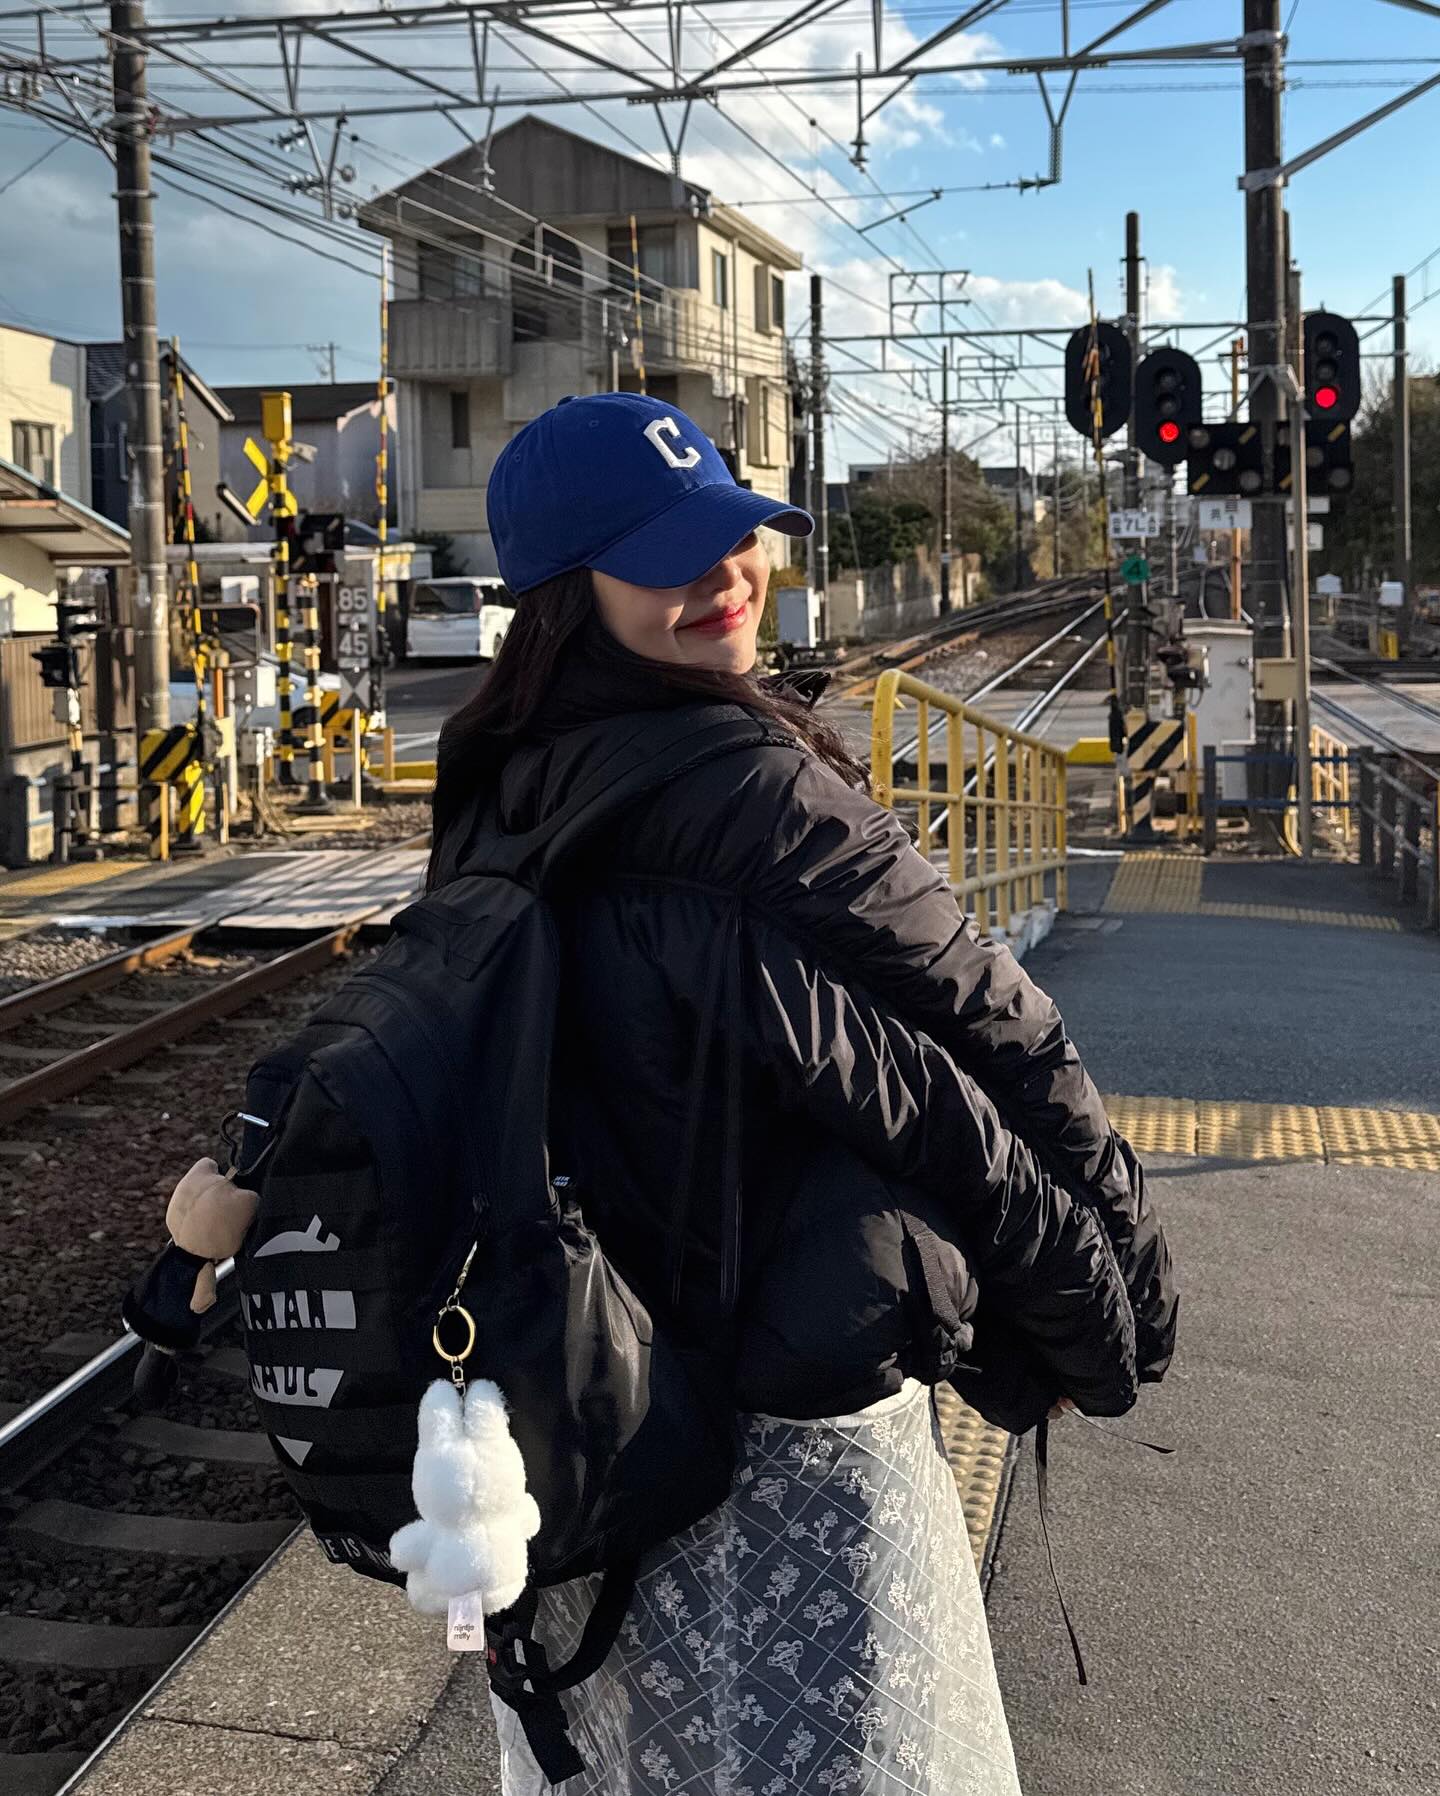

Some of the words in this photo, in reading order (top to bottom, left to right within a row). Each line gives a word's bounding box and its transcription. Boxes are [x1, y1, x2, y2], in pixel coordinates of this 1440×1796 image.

[643, 416, 701, 469] C
[338, 587, 368, 611] 85
[338, 632, 368, 656] 45
